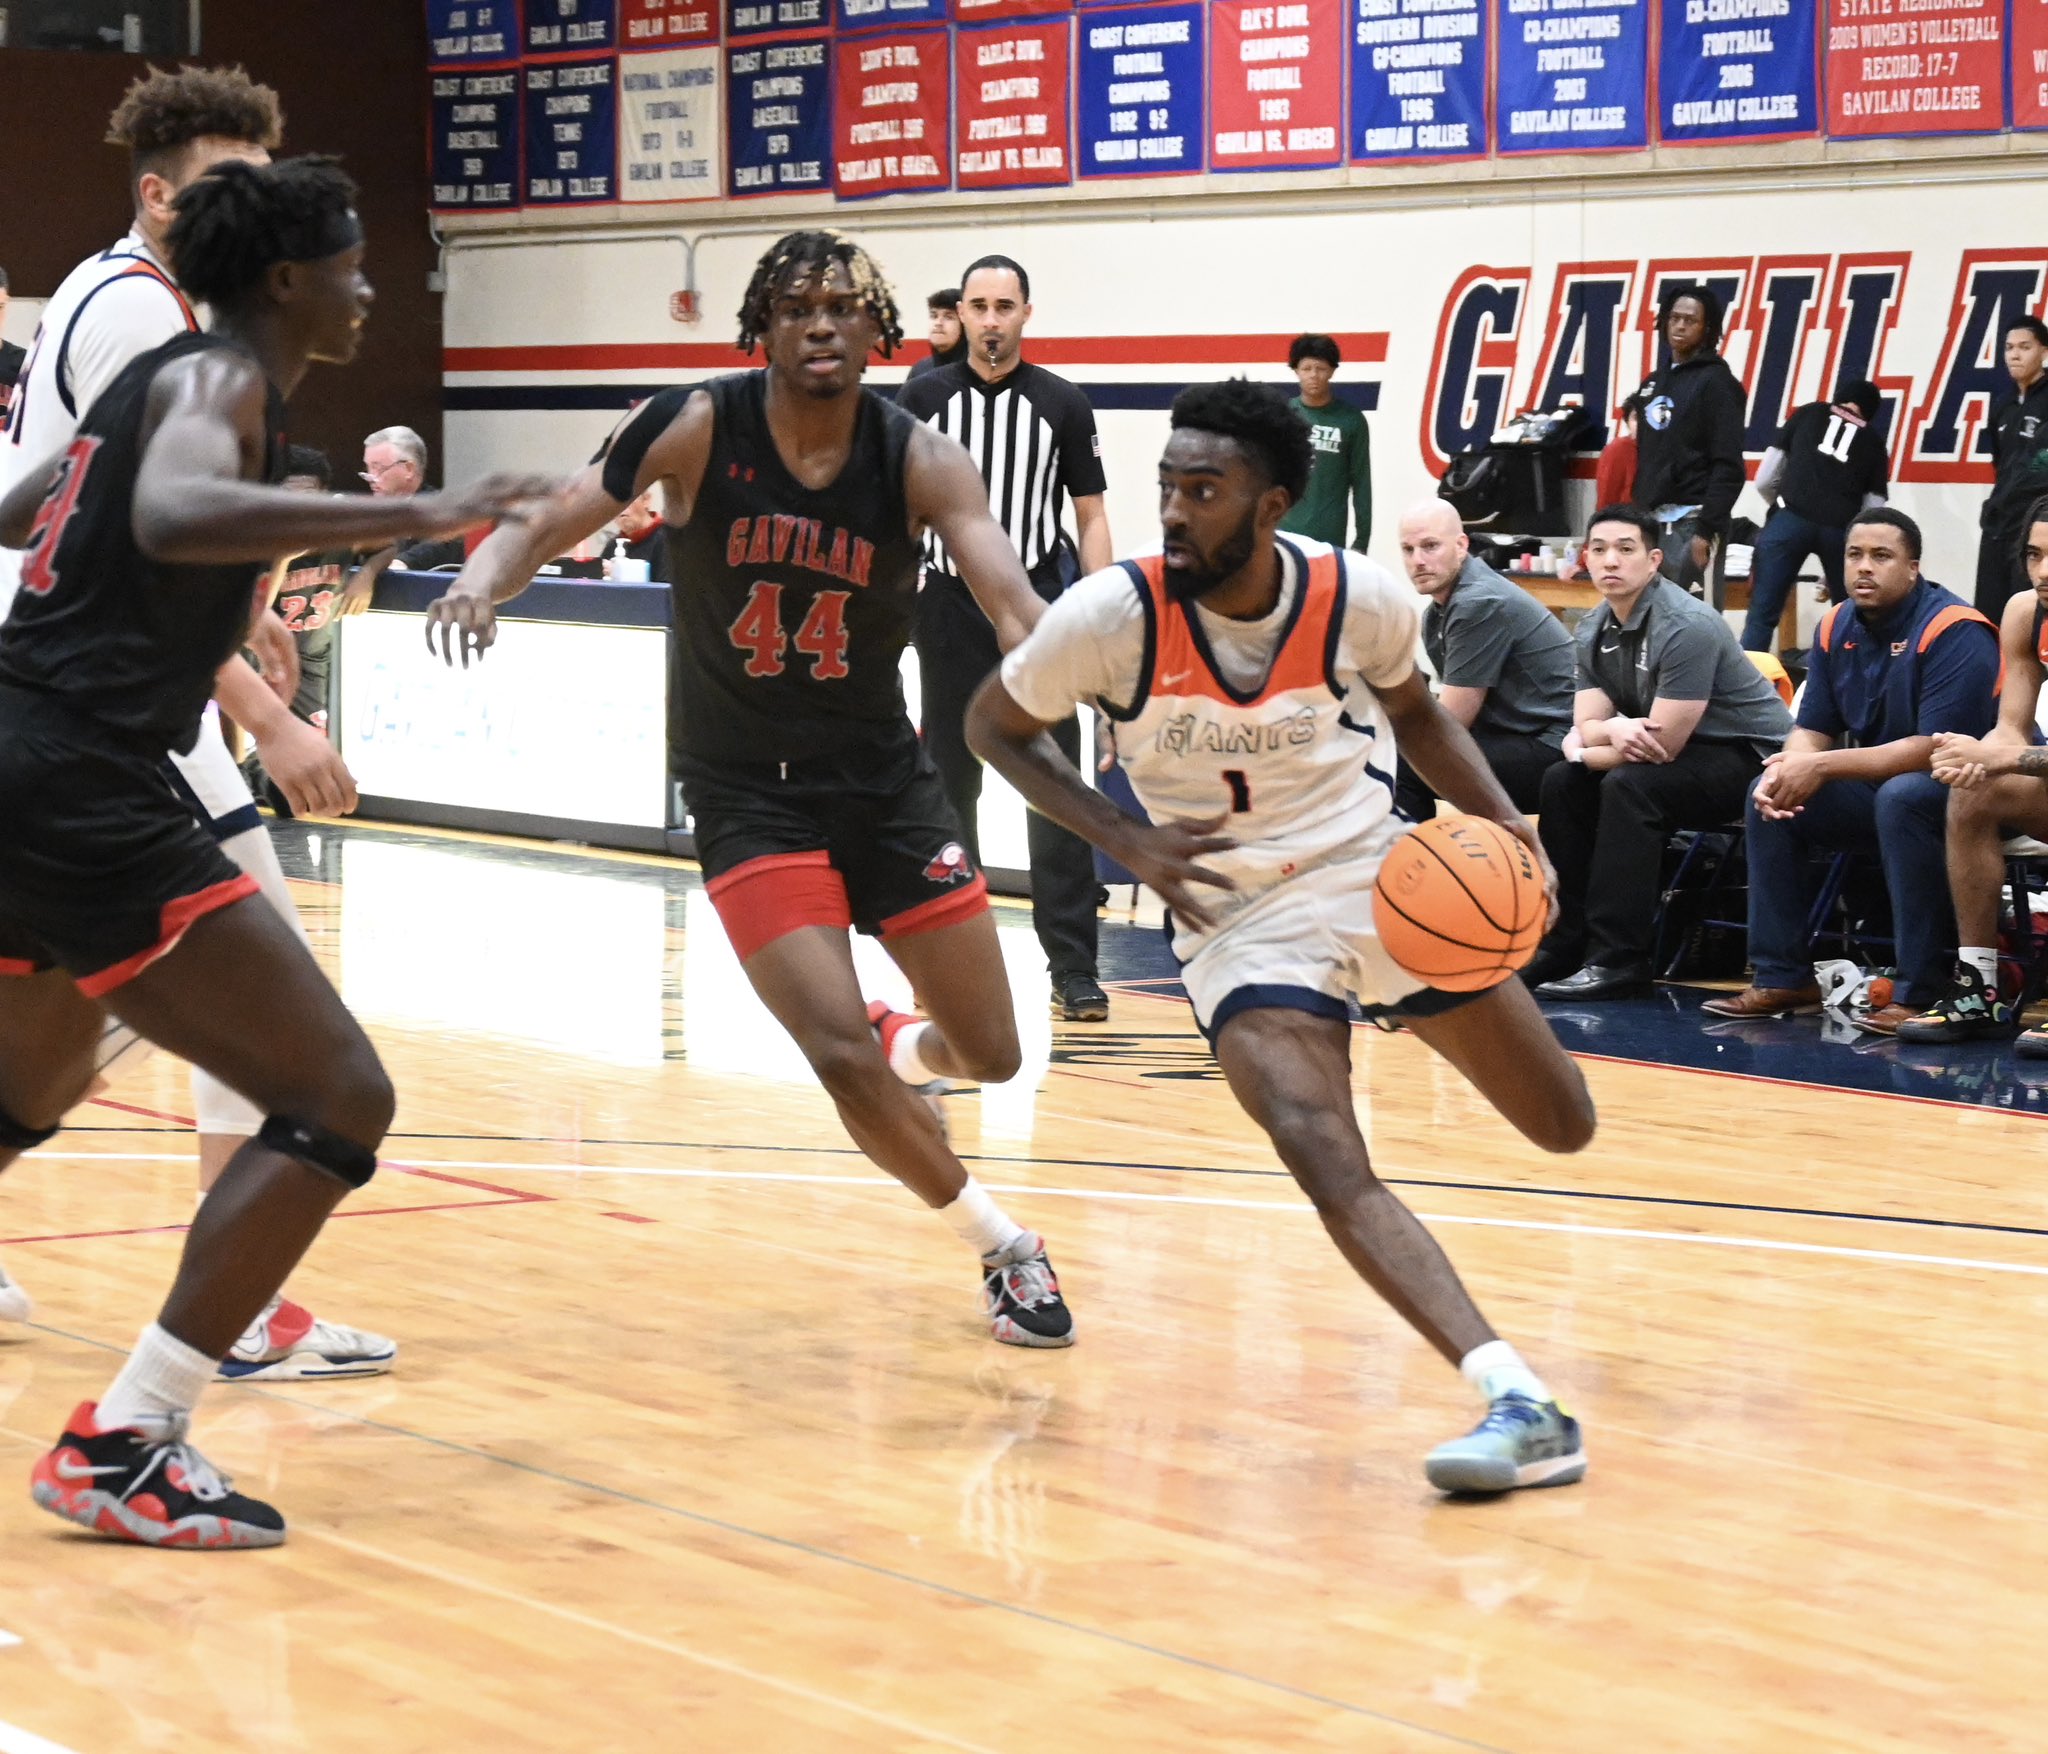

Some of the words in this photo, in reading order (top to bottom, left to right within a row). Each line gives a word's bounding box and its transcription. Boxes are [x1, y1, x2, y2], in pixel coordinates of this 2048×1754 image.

[1523, 15, 1621, 43] CO-CHAMPIONS
[1701, 28, 1774, 57] FOOTBALL
[1861, 20, 1918, 48] WOMEN'S
[1920, 16, 2000, 44] VOLLEYBALL
[1537, 46, 1604, 72] FOOTBALL
[1861, 54, 1923, 81] RECORD:
[1927, 52, 1959, 76] 17-7
[1388, 70, 1445, 96] FOOTBALL
[1672, 99, 1736, 127] GAVILAN
[1737, 94, 1799, 121] COLLEGE
[1842, 89, 1911, 116] GAVILAN
[1913, 86, 1981, 112] COLLEGE
[1510, 109, 1569, 134] GAVILAN
[1571, 106, 1626, 131] COLLEGE
[1417, 123, 1469, 149] COLLEGE
[1819, 416, 1857, 462] 11
[726, 514, 875, 587] GAVILAN
[728, 580, 852, 680] 44
[1222, 769, 1252, 813] 1
